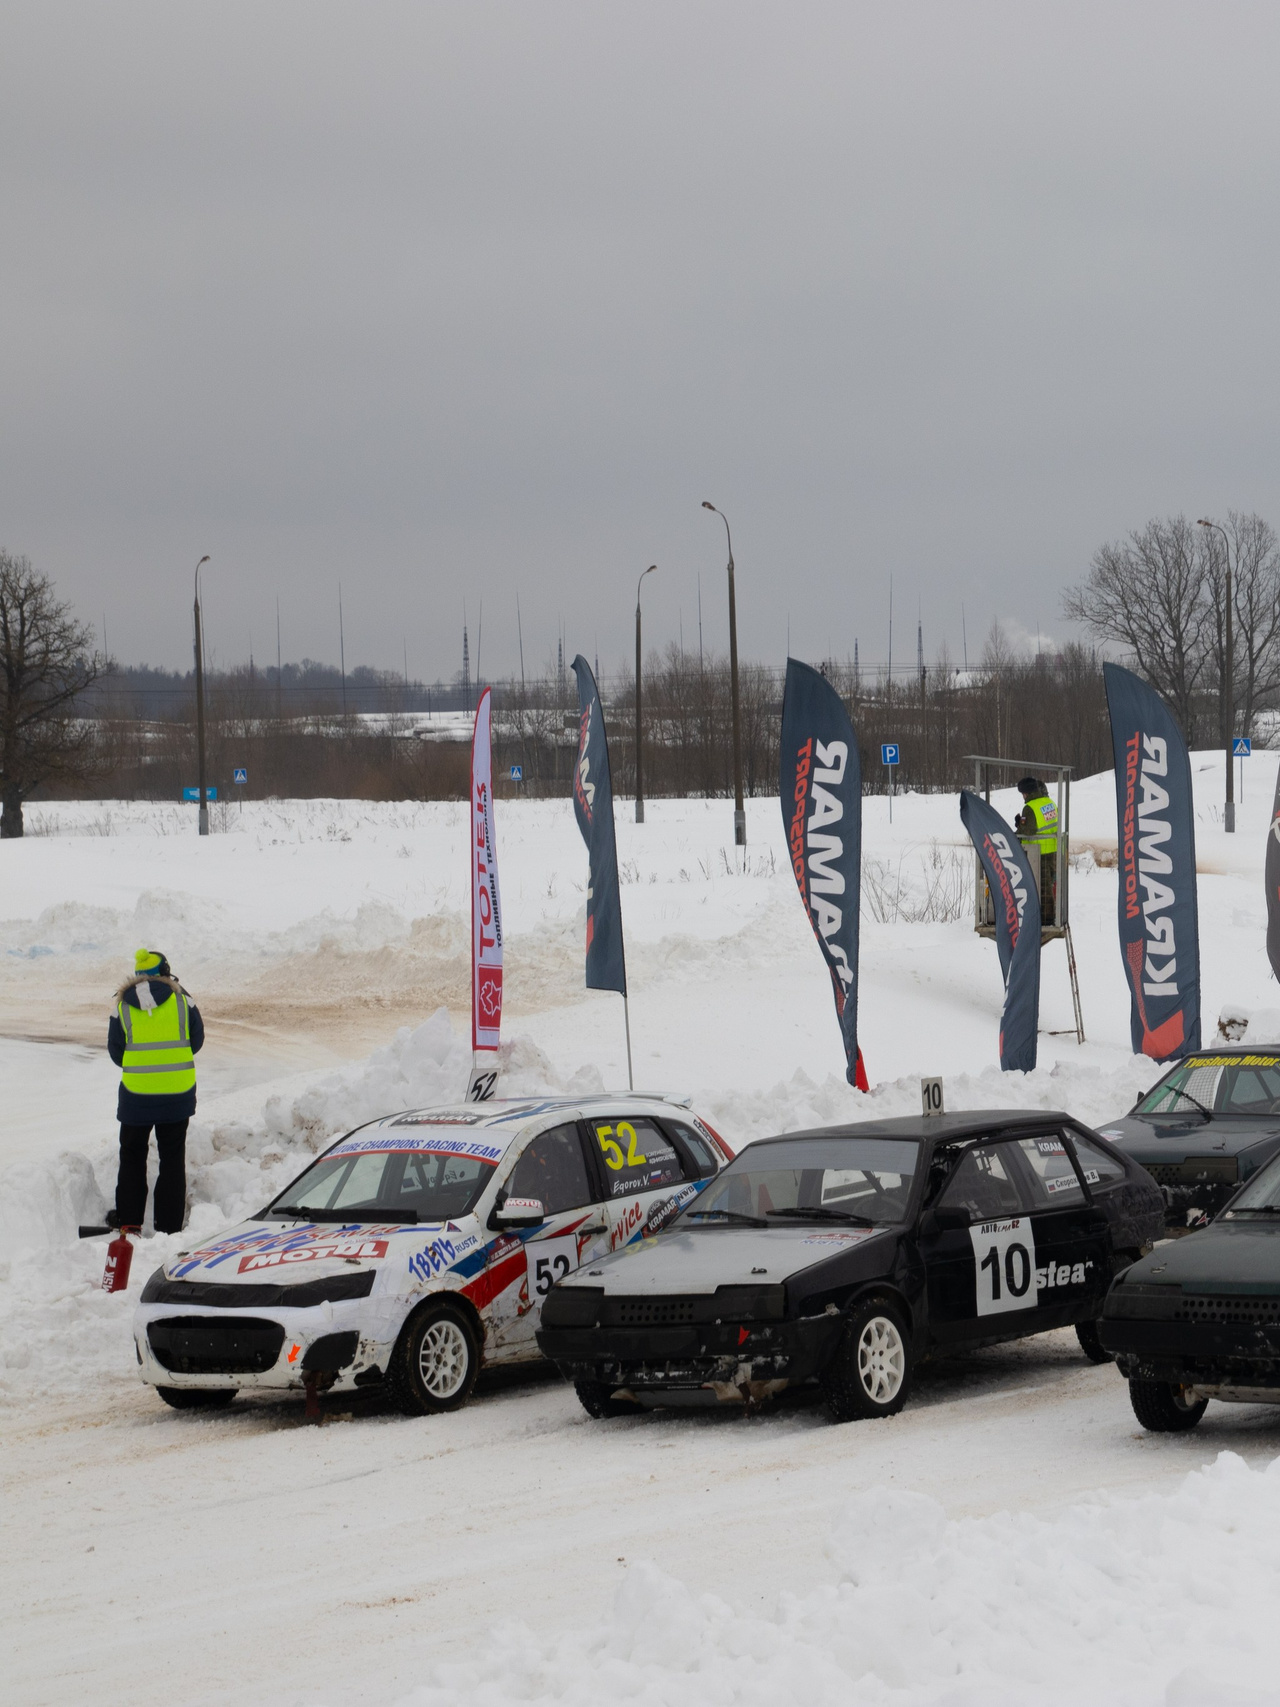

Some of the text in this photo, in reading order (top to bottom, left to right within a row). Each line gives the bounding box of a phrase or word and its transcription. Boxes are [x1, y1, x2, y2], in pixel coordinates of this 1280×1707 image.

[489, 872, 502, 948] ТОПЛИВНЫЕ
[1239, 1055, 1280, 1067] Motor
[470, 1071, 498, 1102] 52
[923, 1083, 943, 1110] 10
[361, 1139, 424, 1151] CHAMPIONS
[425, 1139, 466, 1153] RACING
[467, 1144, 502, 1159] TEAM
[596, 1121, 647, 1171] 52
[1038, 1141, 1065, 1152] KRAM
[677, 1184, 695, 1202] NWB
[647, 1197, 677, 1231] KRAMAR
[246, 1241, 380, 1269] MOTUL
[455, 1235, 478, 1254] RUSTA
[408, 1237, 456, 1282] ТВЕРЬ
[981, 1242, 1031, 1301] 10
[535, 1254, 570, 1296] 52
